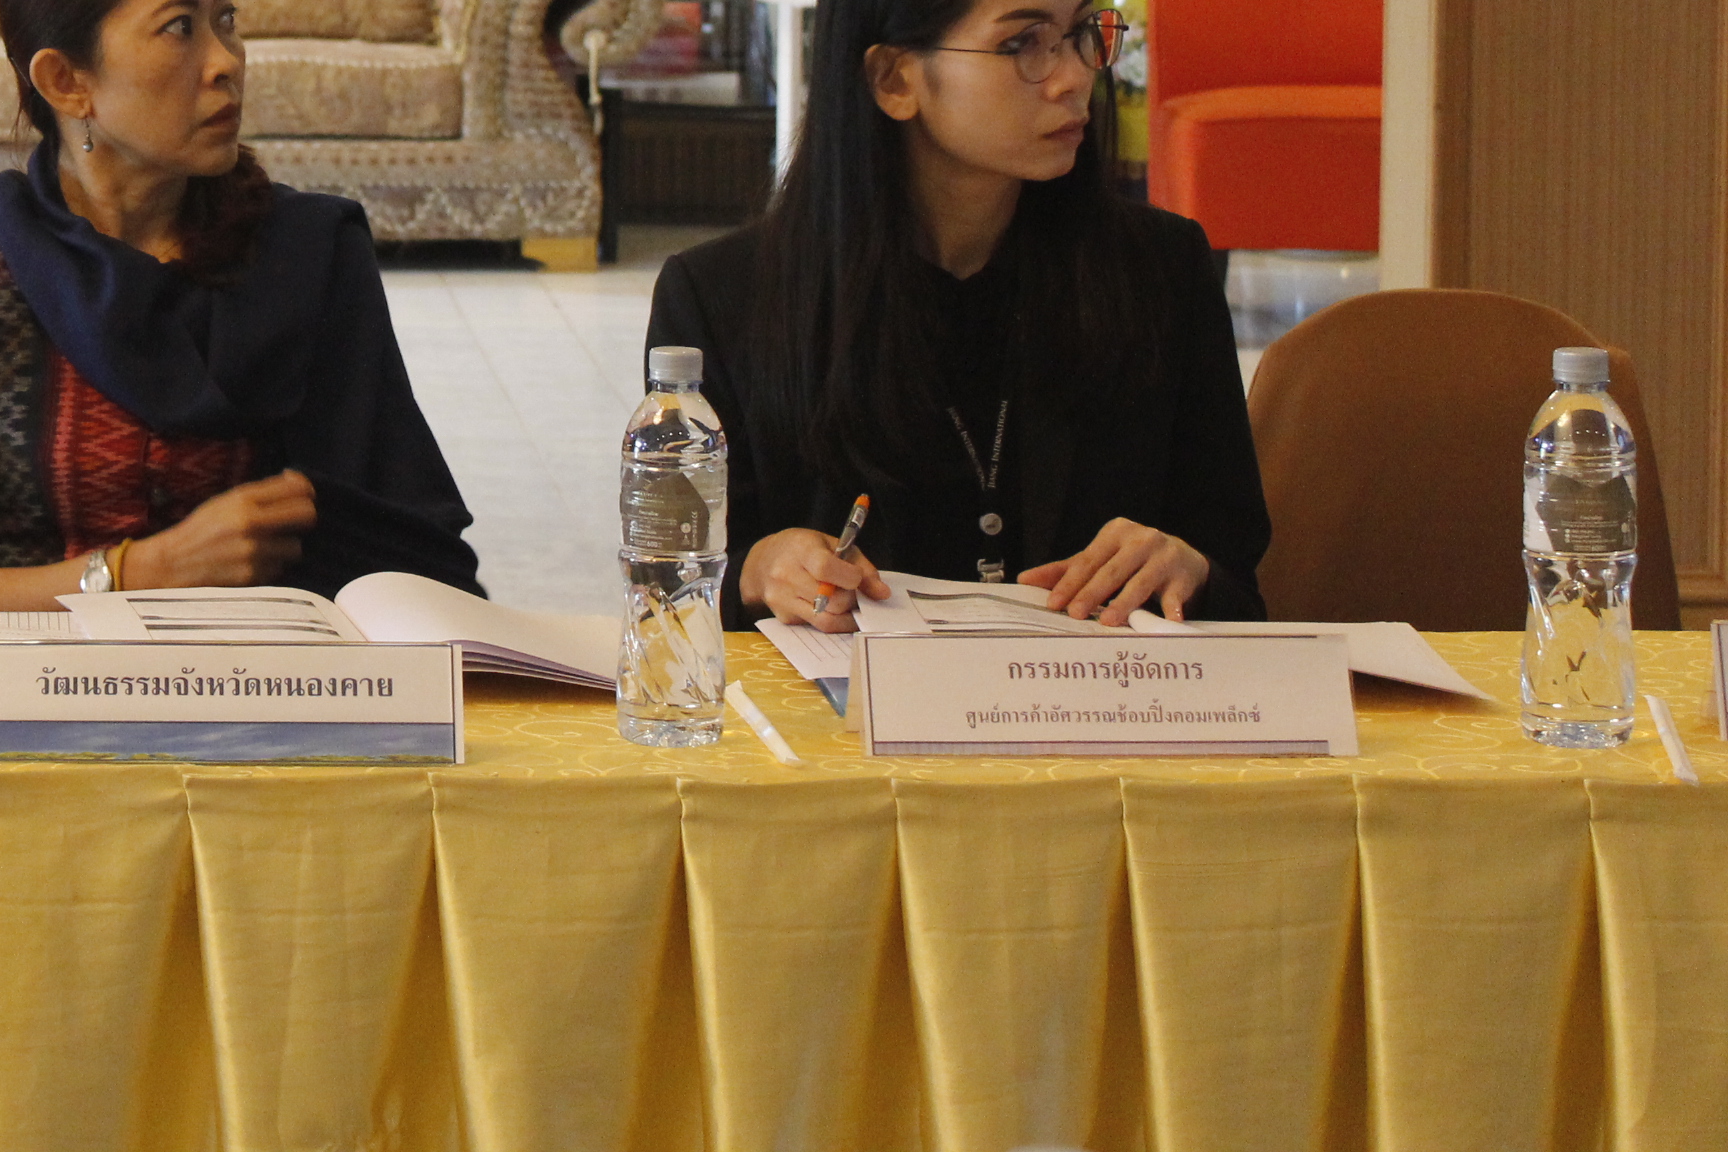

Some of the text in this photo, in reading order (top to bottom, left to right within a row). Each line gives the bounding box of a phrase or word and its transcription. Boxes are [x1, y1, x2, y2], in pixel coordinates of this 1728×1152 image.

[35, 666, 393, 697] วัฒนธรรมจังหวัดหนองคาย
[1008, 650, 1203, 688] กรรมการผู้จัดการ
